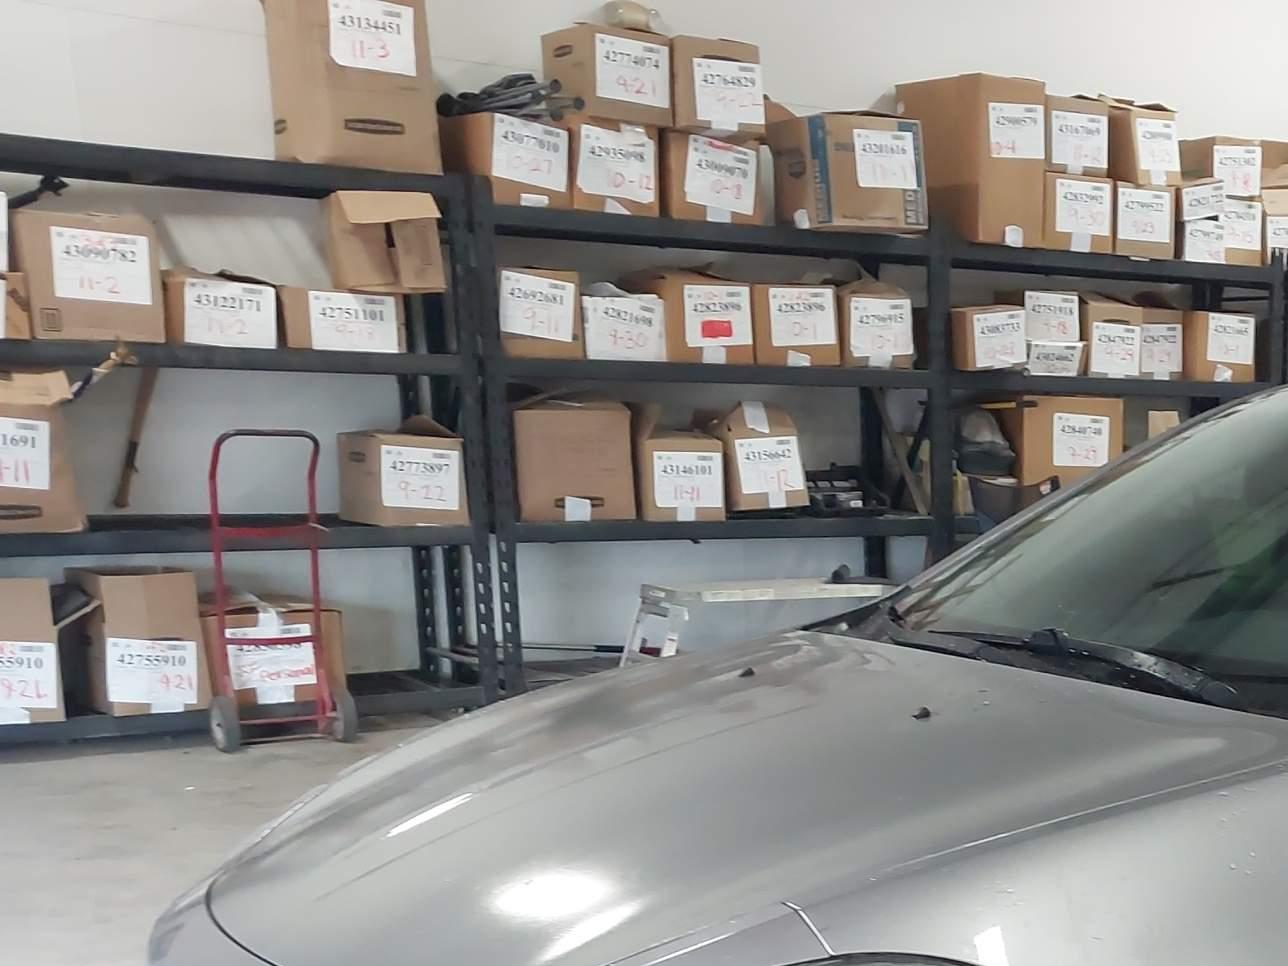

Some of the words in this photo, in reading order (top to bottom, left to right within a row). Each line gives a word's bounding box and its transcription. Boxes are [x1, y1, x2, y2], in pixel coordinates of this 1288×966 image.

[337, 15, 401, 35] 43134451
[193, 293, 262, 312] 43122171
[319, 306, 385, 322] 42751101
[117, 653, 186, 667] 42755910
